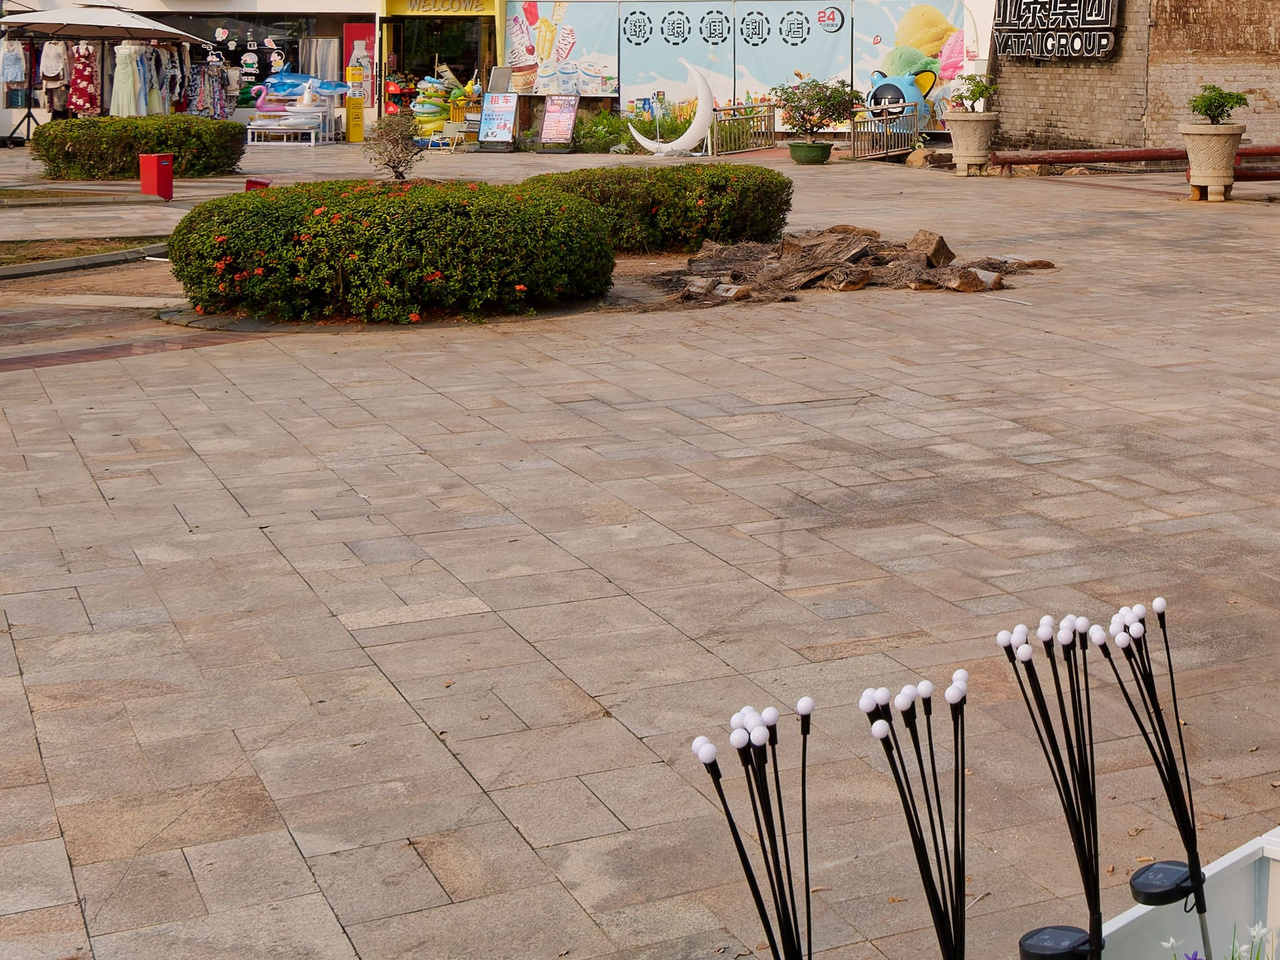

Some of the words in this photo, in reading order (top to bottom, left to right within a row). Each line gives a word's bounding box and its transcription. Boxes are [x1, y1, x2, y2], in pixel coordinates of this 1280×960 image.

[818, 10, 837, 22] 24
[628, 17, 804, 40] 琳琅便利店
[490, 95, 511, 105] 租车
